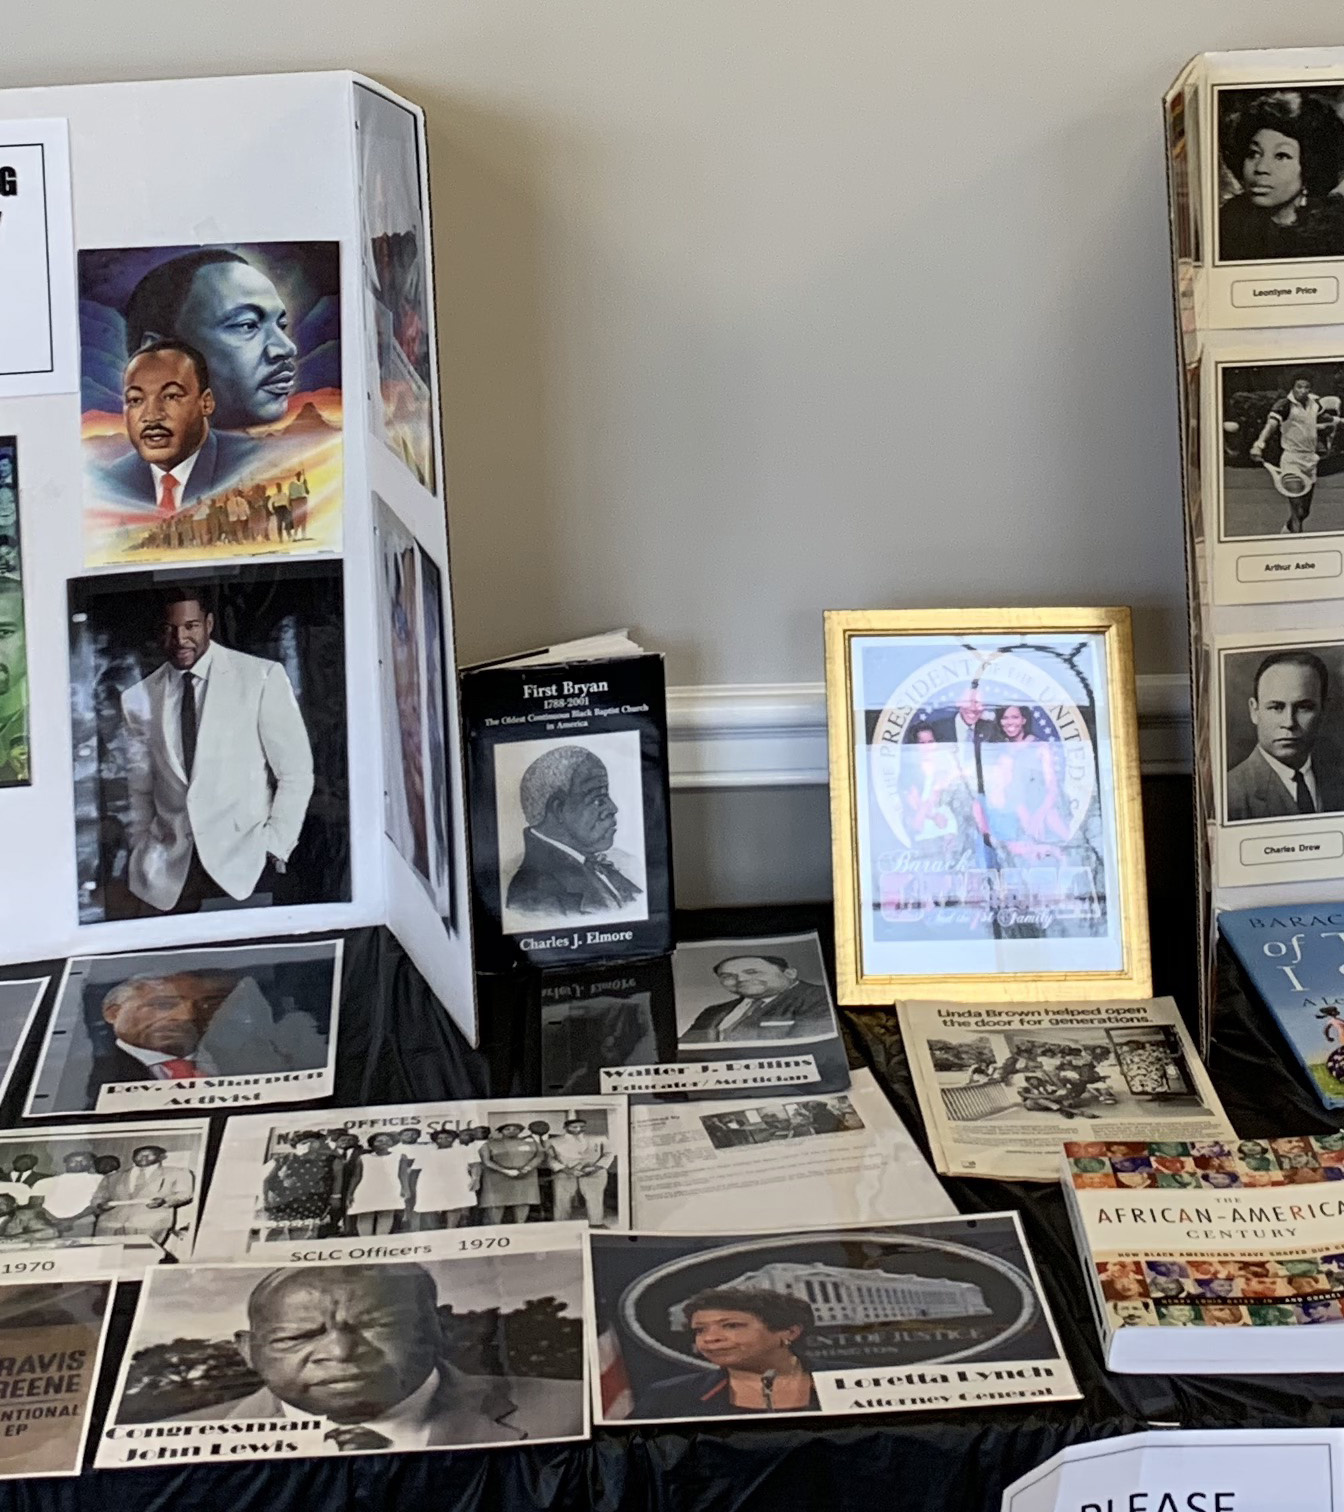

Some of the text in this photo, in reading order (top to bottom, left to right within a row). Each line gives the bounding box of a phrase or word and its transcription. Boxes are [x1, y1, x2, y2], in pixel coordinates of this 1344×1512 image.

[1296, 286, 1317, 295] Price
[1265, 561, 1316, 571] Arthur Ashe
[523, 681, 609, 698] First Bryan
[485, 703, 649, 727] The Oldest Continuous Black Baptist Church
[557, 720, 588, 729] America
[1264, 843, 1321, 854] Charles Drew
[519, 930, 633, 952] Charles J. Elmore
[1263, 934, 1305, 964] of
[1276, 965, 1309, 992] I
[937, 1005, 1147, 1020] Linda Brown helped open
[942, 1014, 1154, 1029] the door for generations.
[106, 1071, 324, 1096] Rev. Al Sharpton
[164, 1091, 262, 1106] Activist
[344, 1116, 422, 1130] OFFICES
[1214, 1196, 1243, 1205] THE
[1186, 1227, 1298, 1240] CENTURY
[290, 1236, 511, 1263] SCLC Officers 1970
[1118, 1251, 1141, 1259] HOW
[1179, 1250, 1236, 1258] AMERICANS
[1239, 1249, 1265, 1257] HAVE
[1269, 1247, 1308, 1256] SHAPED
[1311, 1244, 1332, 1254] OUR
[1, 1260, 56, 1276] 1970
[835, 1366, 1055, 1391] Loretta Lynch
[849, 1388, 1054, 1410] Attorney General
[5, 1423, 28, 1437] EP
[105, 1417, 323, 1443] Congressman
[119, 1438, 299, 1464] John Lewis
